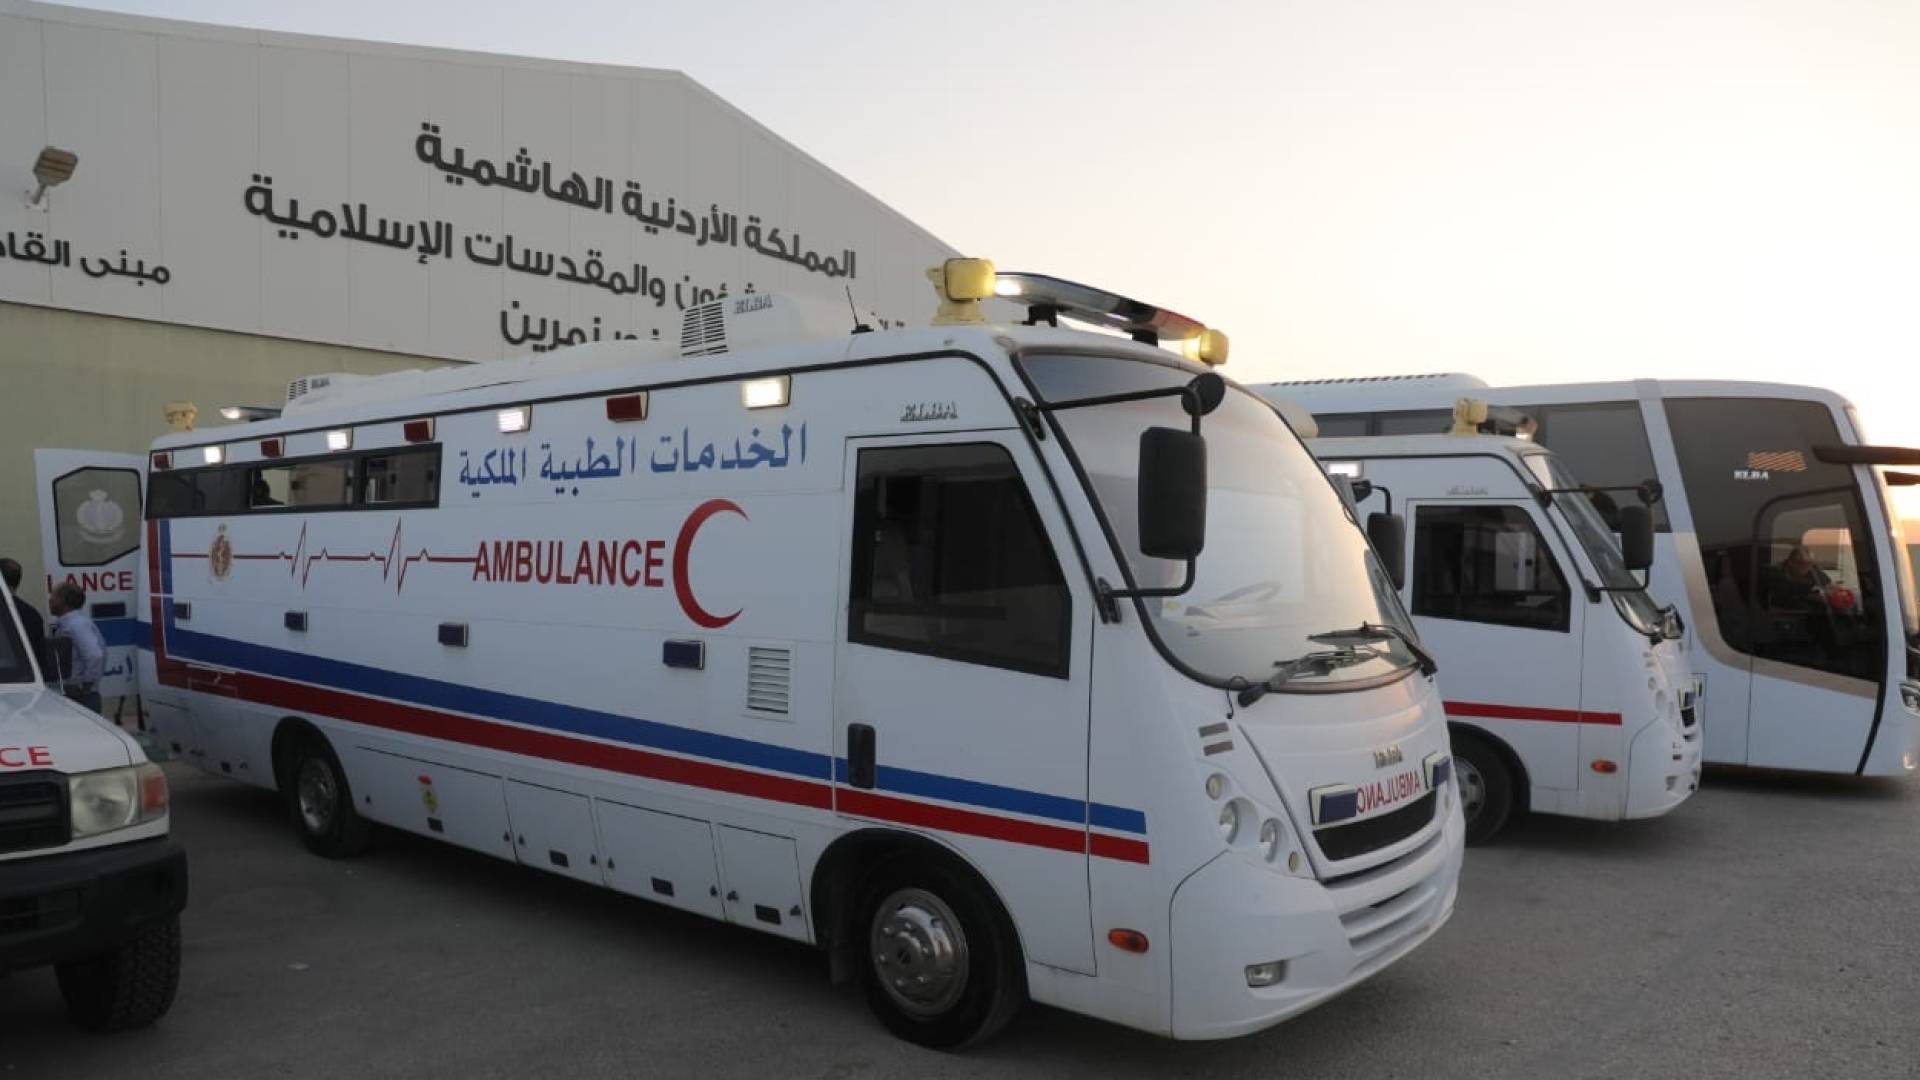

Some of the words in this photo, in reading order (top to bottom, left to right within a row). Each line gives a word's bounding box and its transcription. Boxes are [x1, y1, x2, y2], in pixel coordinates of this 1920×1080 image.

[415, 122, 613, 214] الهاشمية
[243, 173, 453, 265] الإسلامية
[621, 180, 738, 247] الأردنية
[79, 249, 171, 287] مبنى
[464, 233, 667, 307] والمقدسات
[744, 215, 857, 279] المملكة
[459, 445, 527, 499] الملكية
[539, 434, 637, 498] الطبية
[650, 419, 807, 473] الخدمات
[472, 539, 666, 588] AMBULANCE
